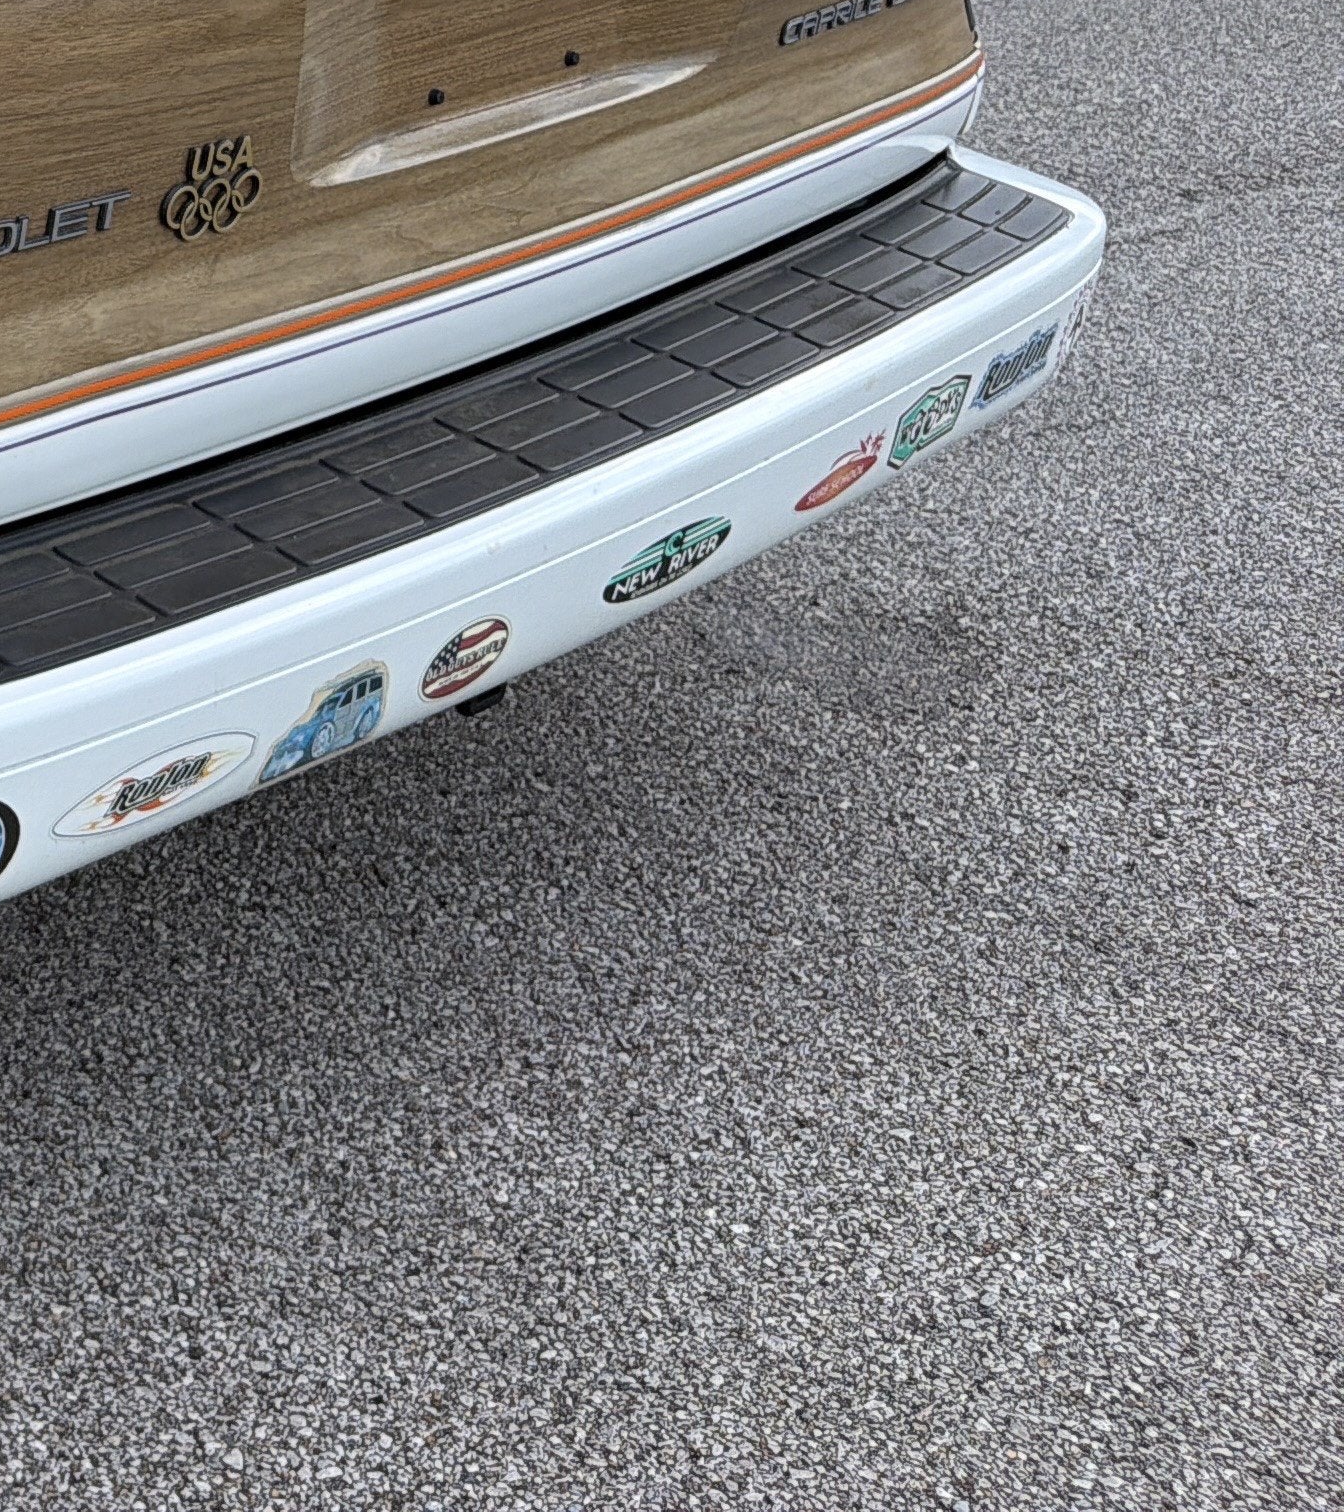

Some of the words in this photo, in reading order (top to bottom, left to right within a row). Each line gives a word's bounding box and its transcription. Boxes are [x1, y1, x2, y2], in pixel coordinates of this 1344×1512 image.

[187, 135, 253, 182] USA
[611, 562, 662, 601] NEW
[667, 533, 720, 575] RIVER
